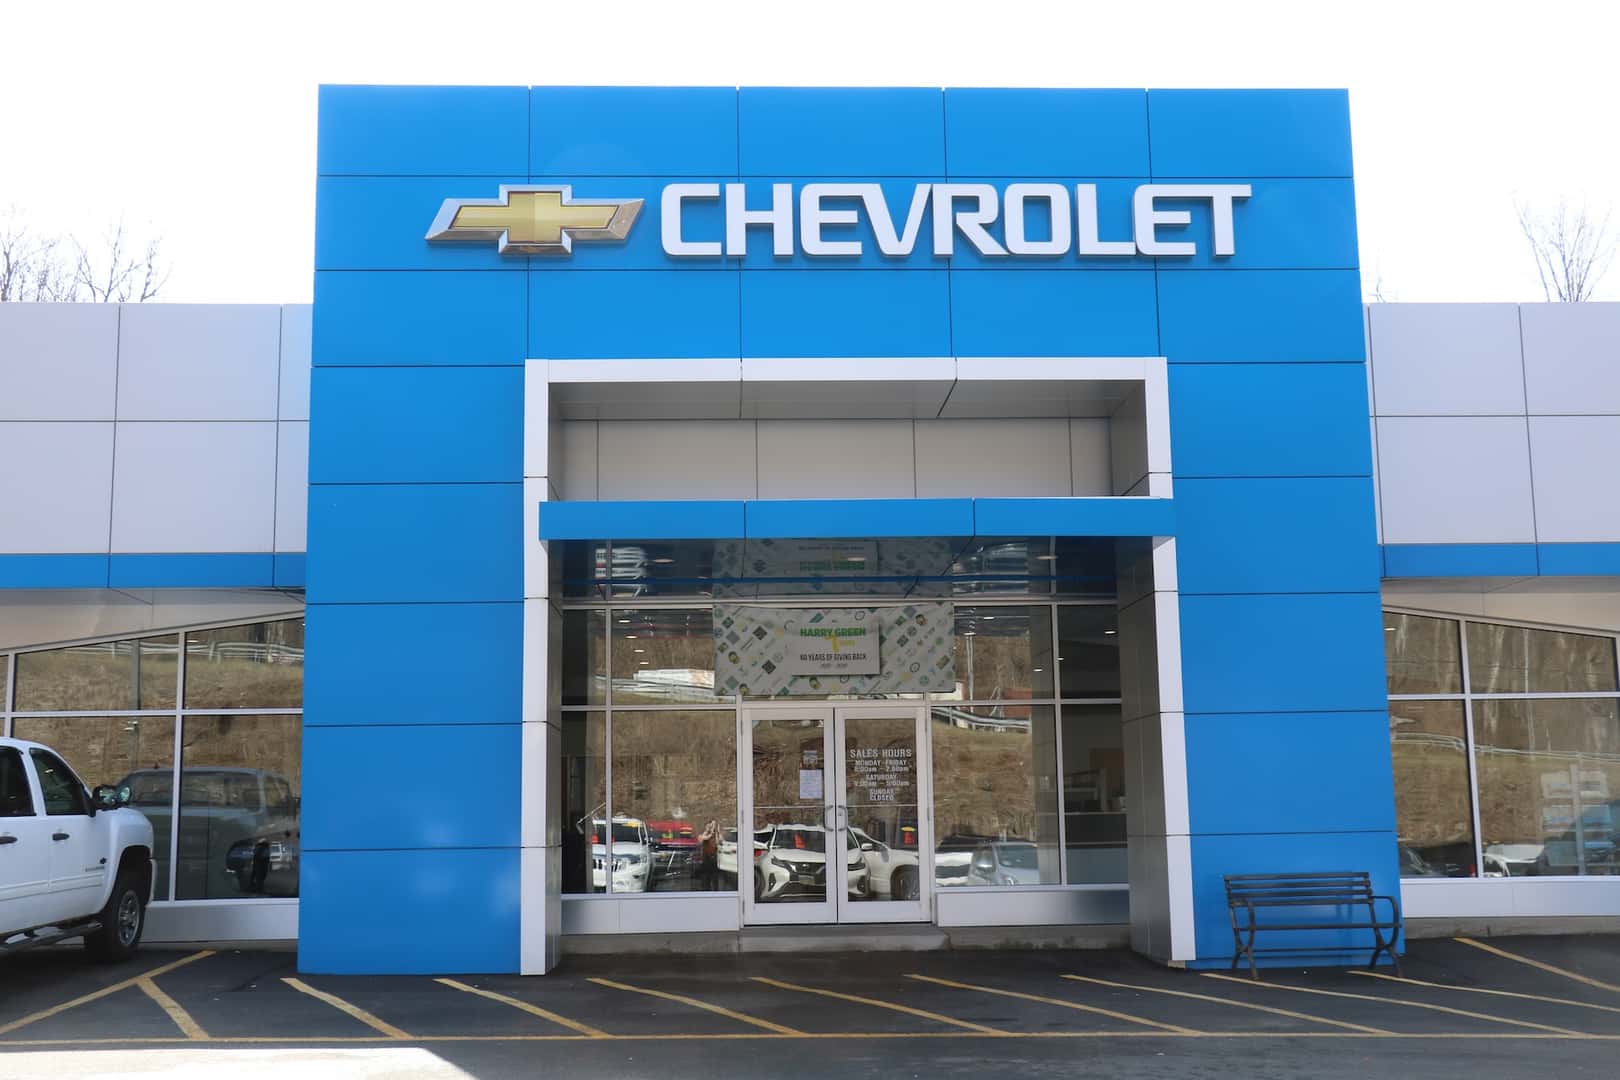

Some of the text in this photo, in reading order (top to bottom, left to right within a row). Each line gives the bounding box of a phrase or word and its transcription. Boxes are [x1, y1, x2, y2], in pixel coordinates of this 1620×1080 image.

[661, 183, 1252, 257] CHEVROLET
[800, 628, 866, 637] HARRY GREEN
[850, 748, 913, 758] SALES HOURS
